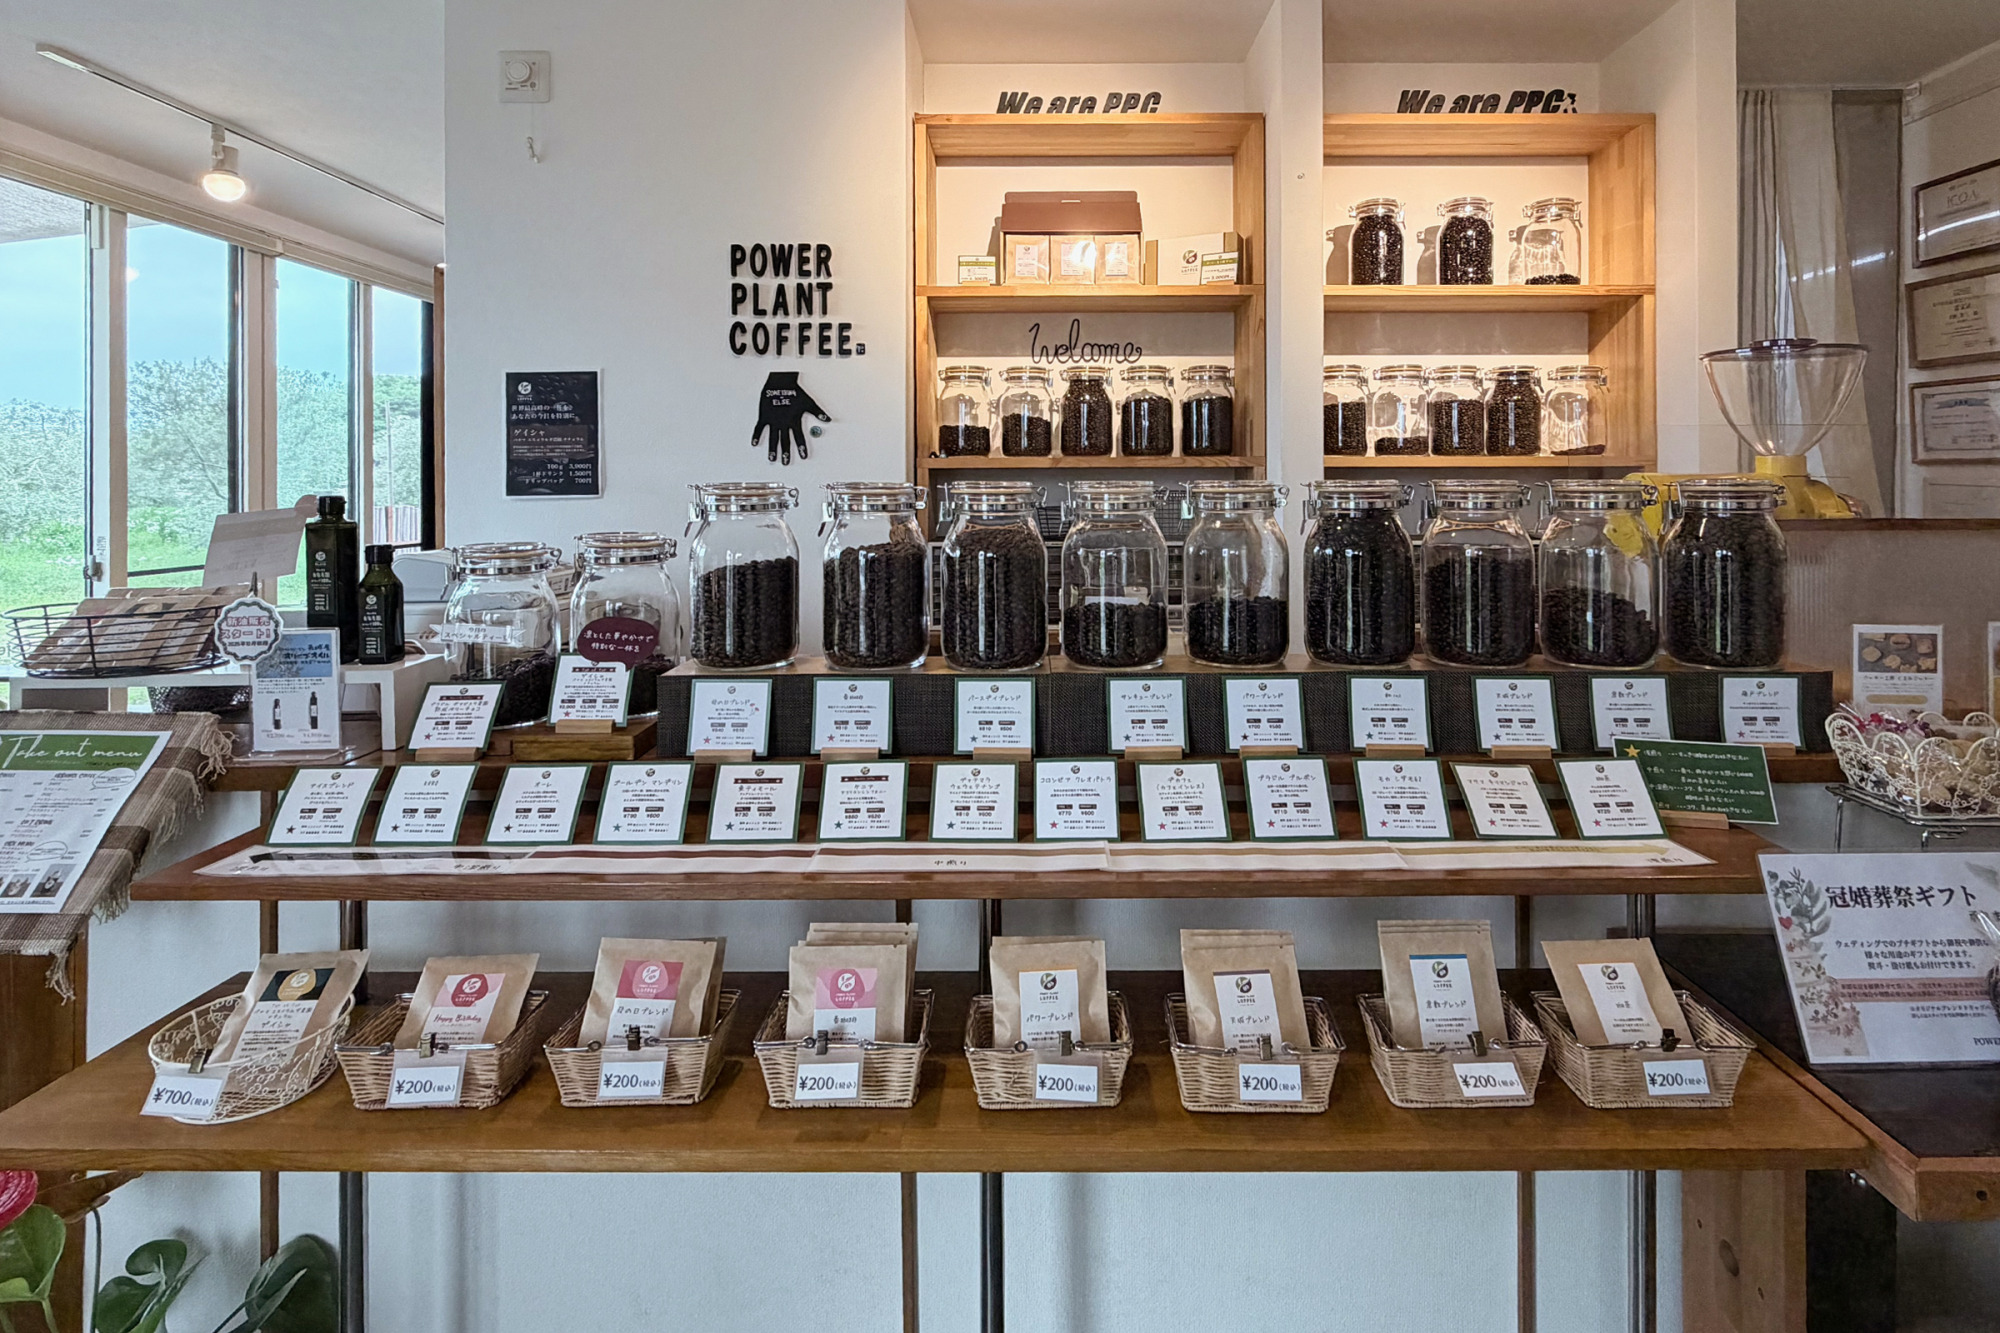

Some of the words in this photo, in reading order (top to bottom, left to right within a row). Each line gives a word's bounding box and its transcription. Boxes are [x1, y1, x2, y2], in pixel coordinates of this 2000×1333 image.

[730, 243, 833, 277] POWER
[731, 282, 833, 316] PLANT
[729, 322, 852, 355] COFFEE
[772, 398, 791, 406] ELSE
[226, 616, 270, 626] 新油販売
[2, 734, 48, 768] Take
[55, 738, 92, 757] out
[1825, 885, 1977, 909] 冠婚葬祭ギフト
[434, 1014, 452, 1023] Happy
[455, 1014, 482, 1022] Birthday
[617, 1006, 668, 1015] 母の日ブレンド
[1027, 1012, 1073, 1022] パワーブレンド
